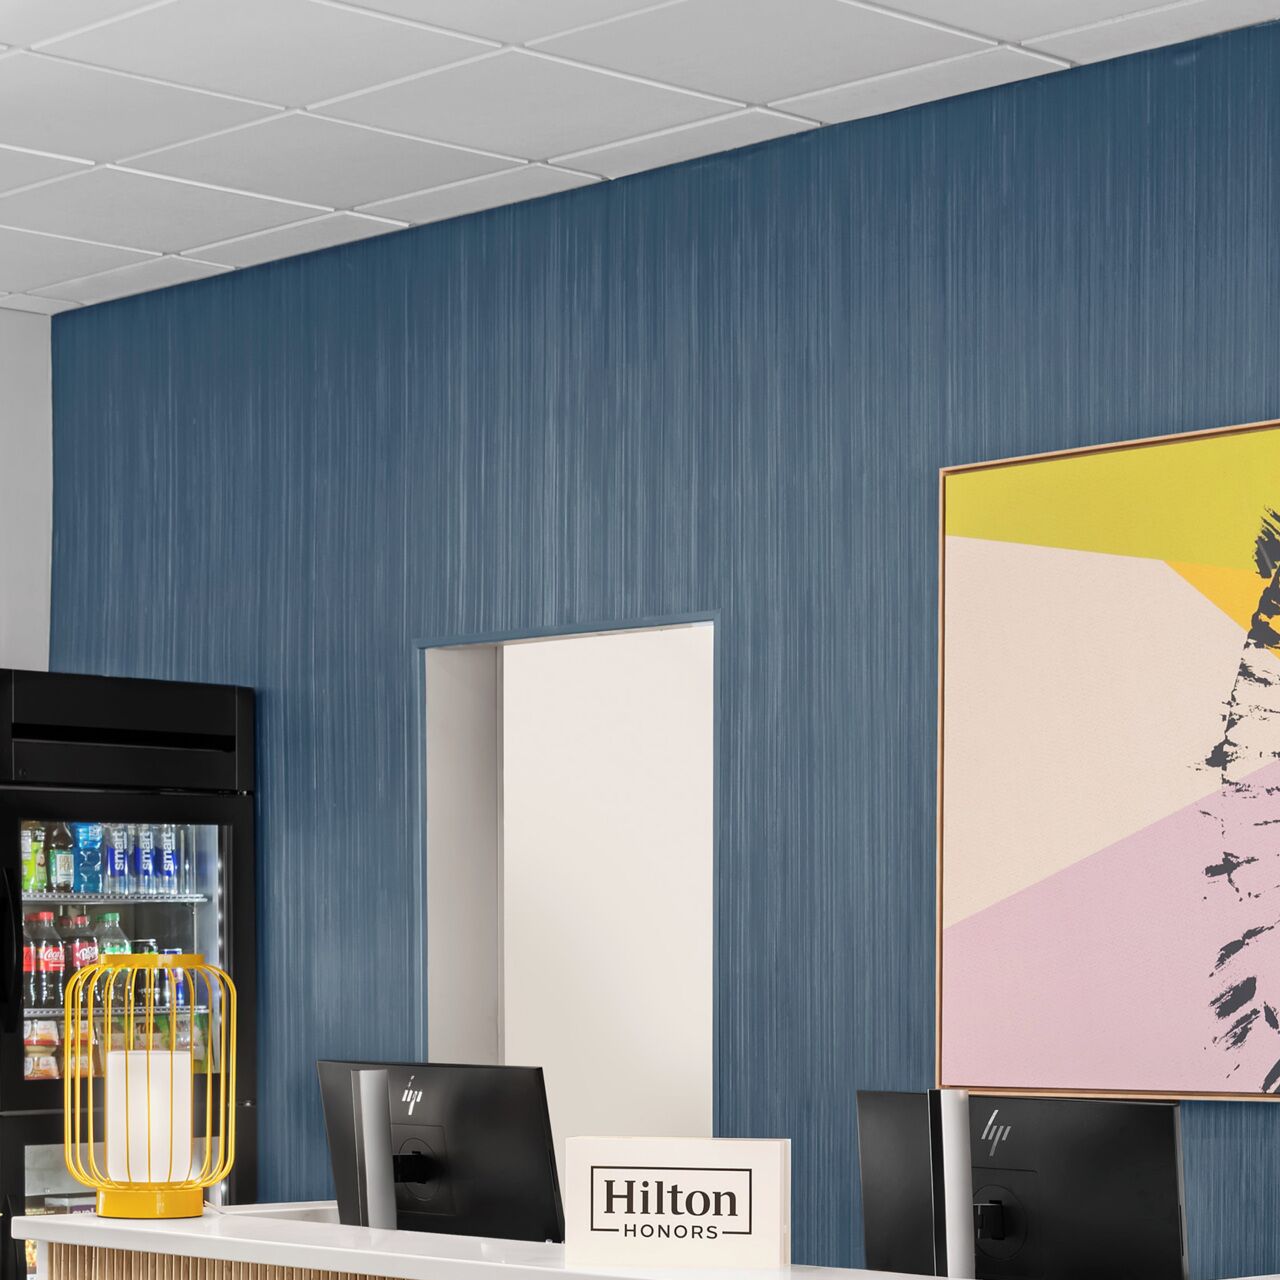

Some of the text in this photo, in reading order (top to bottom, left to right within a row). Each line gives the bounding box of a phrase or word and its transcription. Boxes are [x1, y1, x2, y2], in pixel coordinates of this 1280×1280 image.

[114, 831, 126, 871] smart
[140, 831, 151, 871] smart
[161, 831, 173, 871] smart
[981, 1108, 1012, 1157] hp
[604, 1179, 738, 1217] Hilton
[624, 1223, 718, 1239] HONORS
